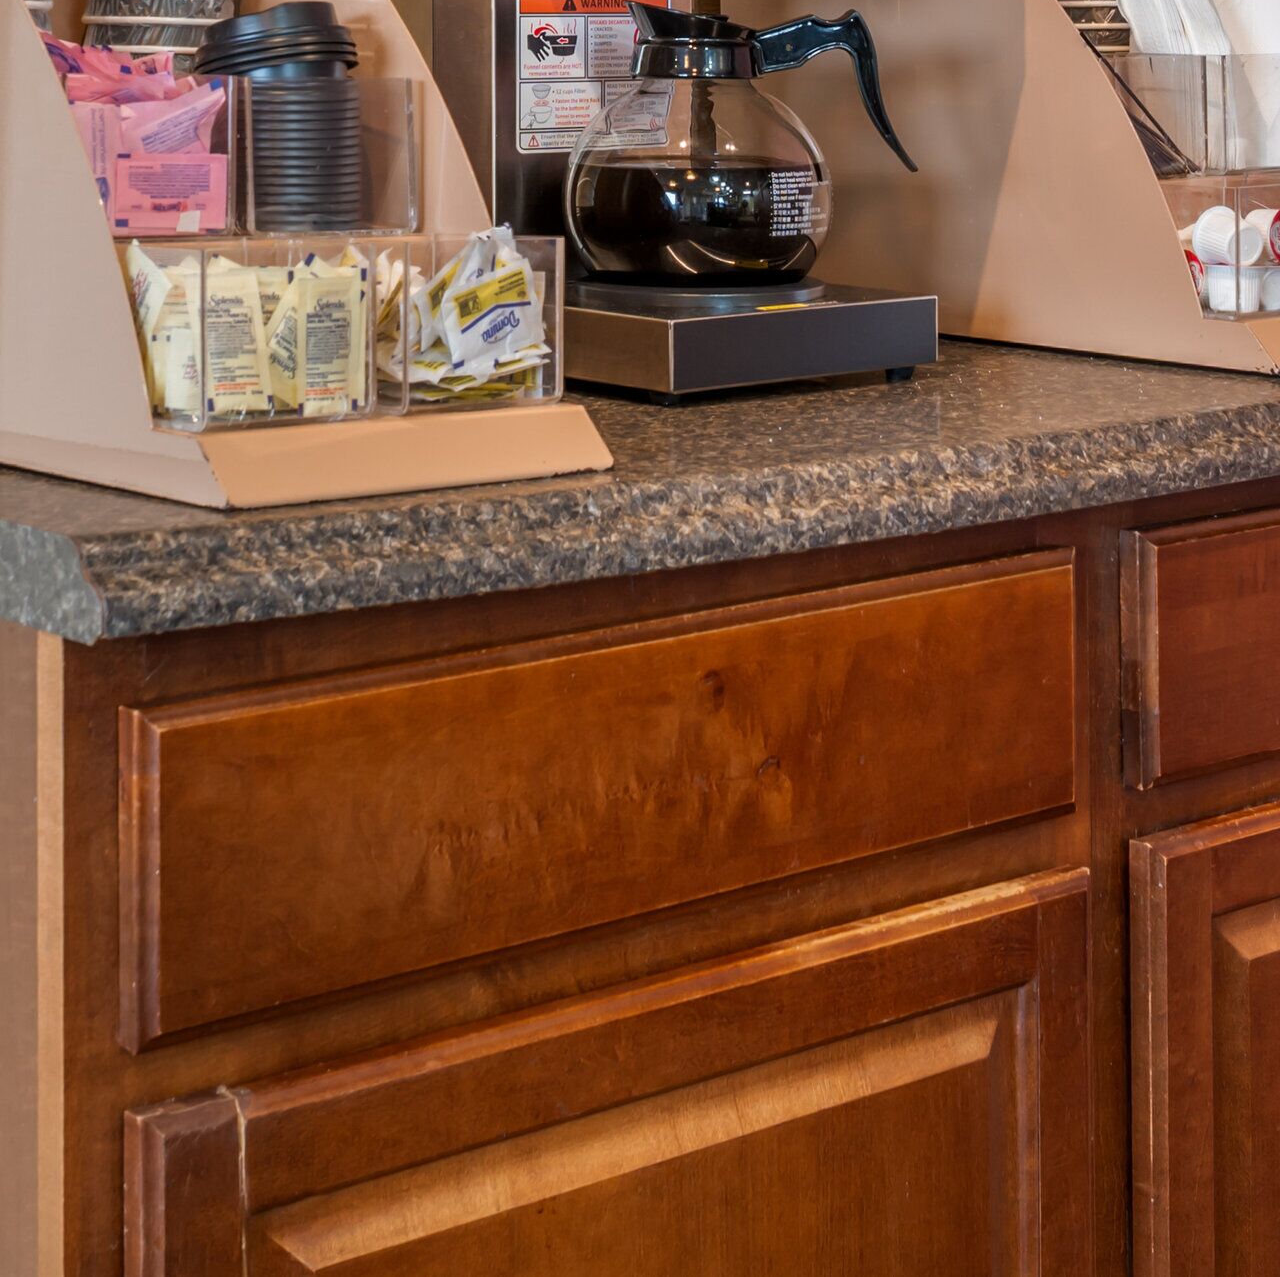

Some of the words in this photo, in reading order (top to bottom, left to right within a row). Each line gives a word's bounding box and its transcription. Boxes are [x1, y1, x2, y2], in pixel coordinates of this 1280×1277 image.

[208, 294, 244, 307] Splenda
[314, 298, 345, 312] Splenda
[481, 310, 520, 342] Domino
